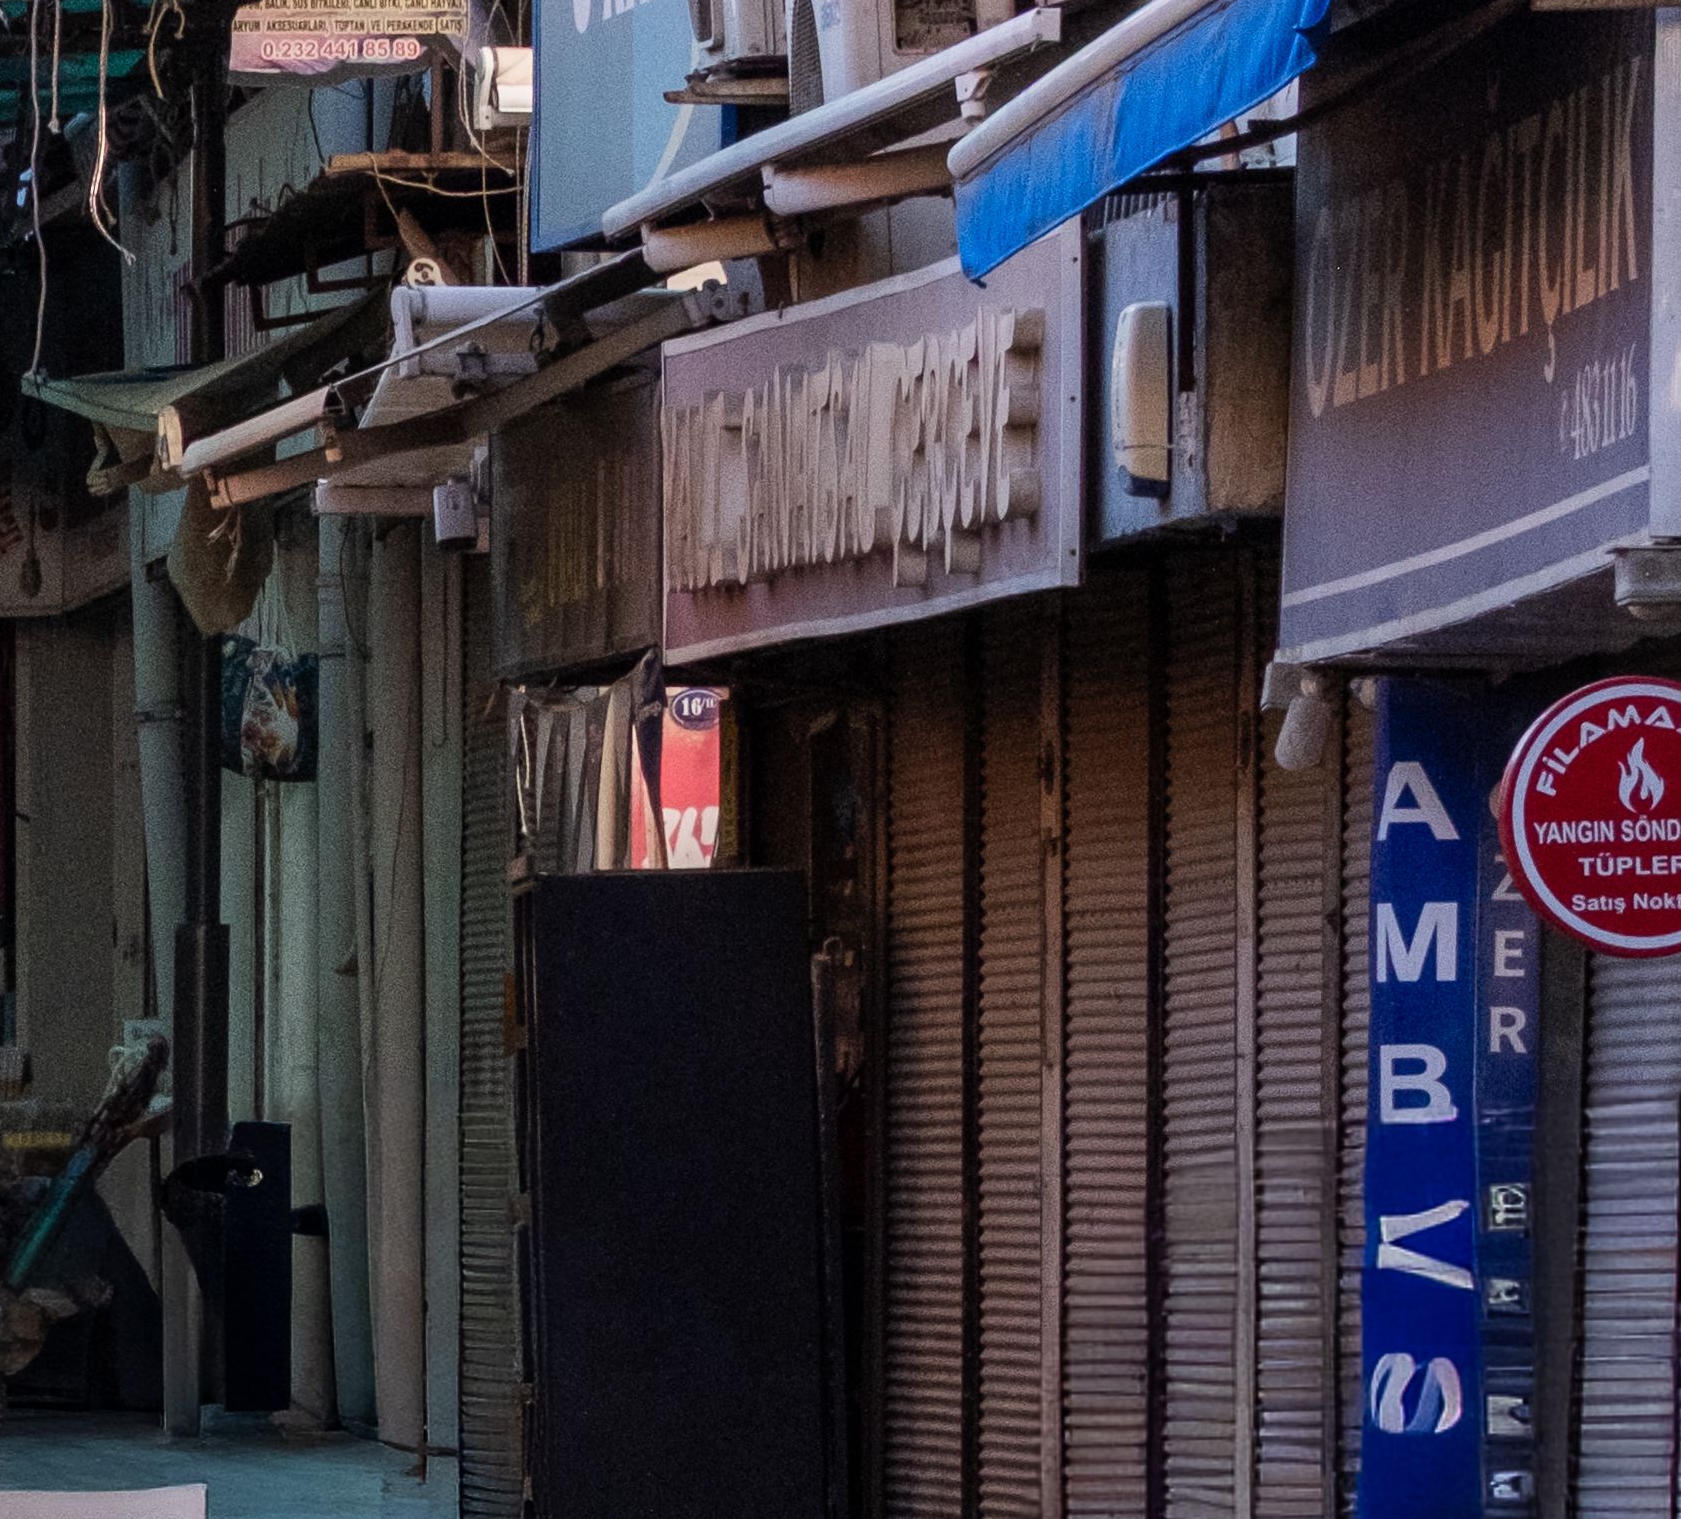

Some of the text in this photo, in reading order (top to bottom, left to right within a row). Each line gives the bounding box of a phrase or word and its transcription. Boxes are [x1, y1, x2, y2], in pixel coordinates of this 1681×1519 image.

[321, 41, 357, 58] 441
[364, 41, 388, 57] 85
[395, 40, 419, 57] 89
[1534, 820, 1614, 844] YANGIN
[1572, 893, 1626, 913] Satış
